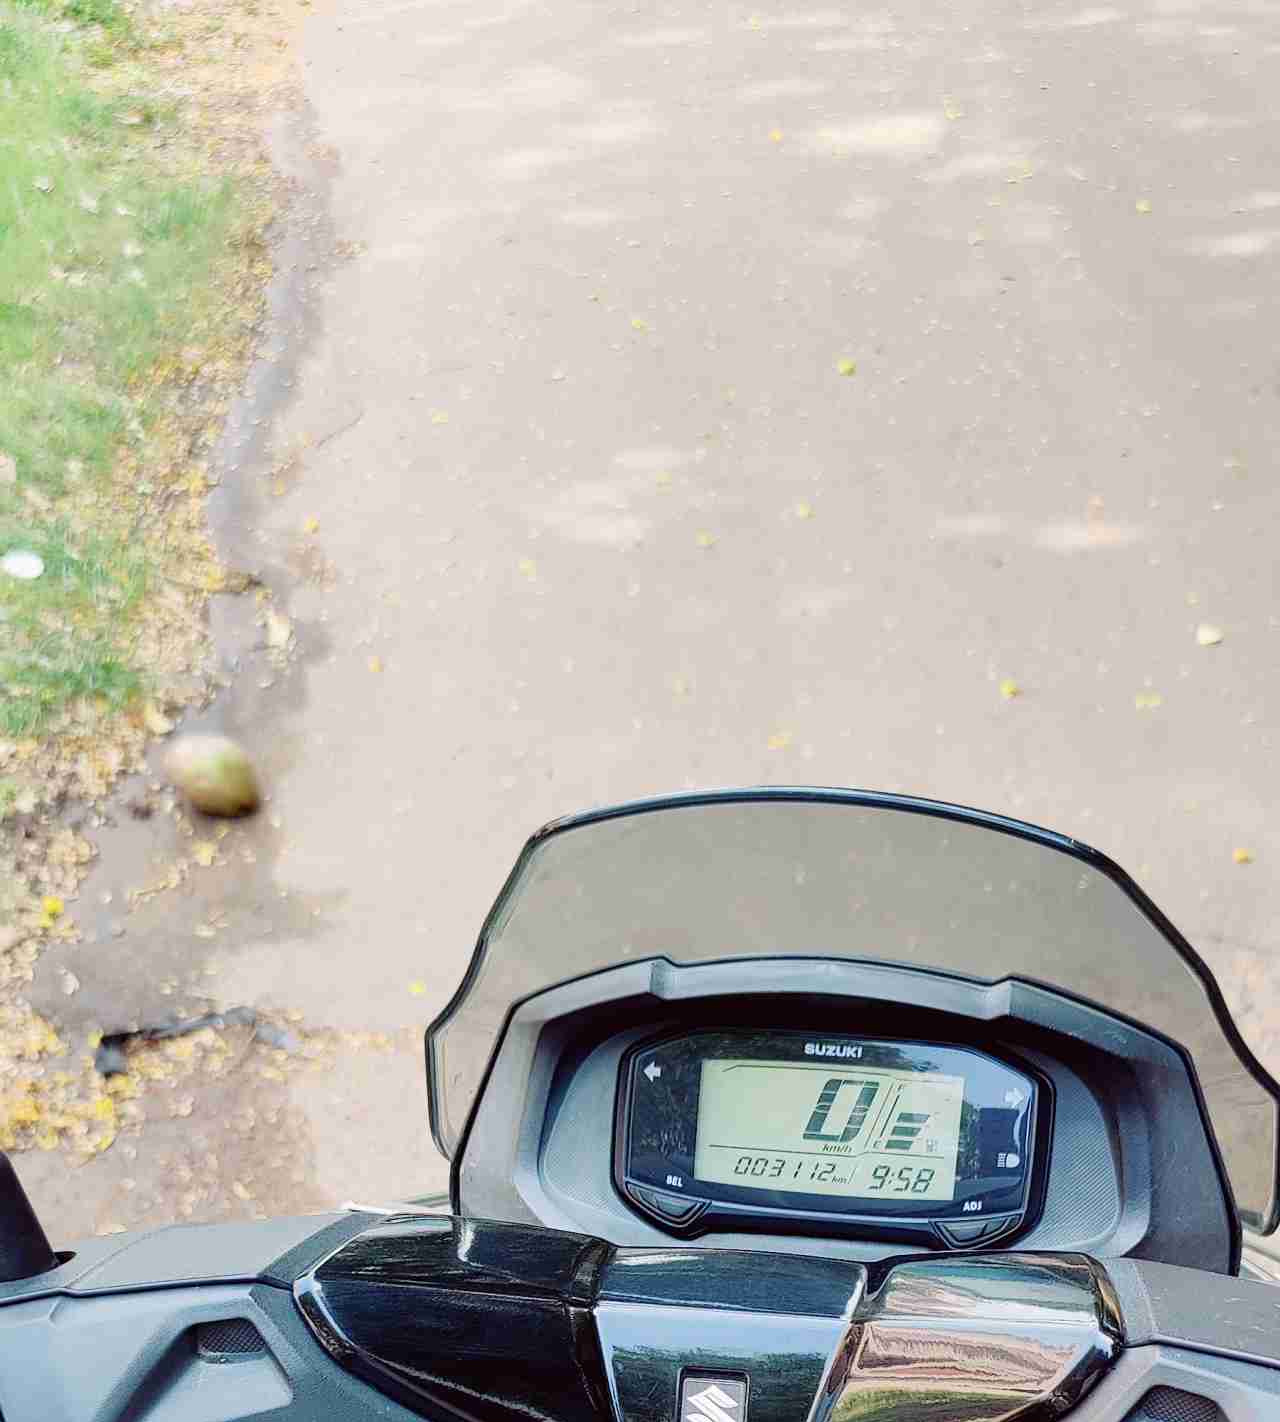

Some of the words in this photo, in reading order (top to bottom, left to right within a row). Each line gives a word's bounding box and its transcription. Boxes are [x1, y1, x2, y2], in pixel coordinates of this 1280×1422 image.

[804, 1043, 863, 1058] SUZUKI
[822, 1144, 853, 1153] km/h
[734, 1156, 836, 1182] 003112
[868, 1165, 936, 1193] 9:58
[962, 1200, 983, 1212] ADJ
